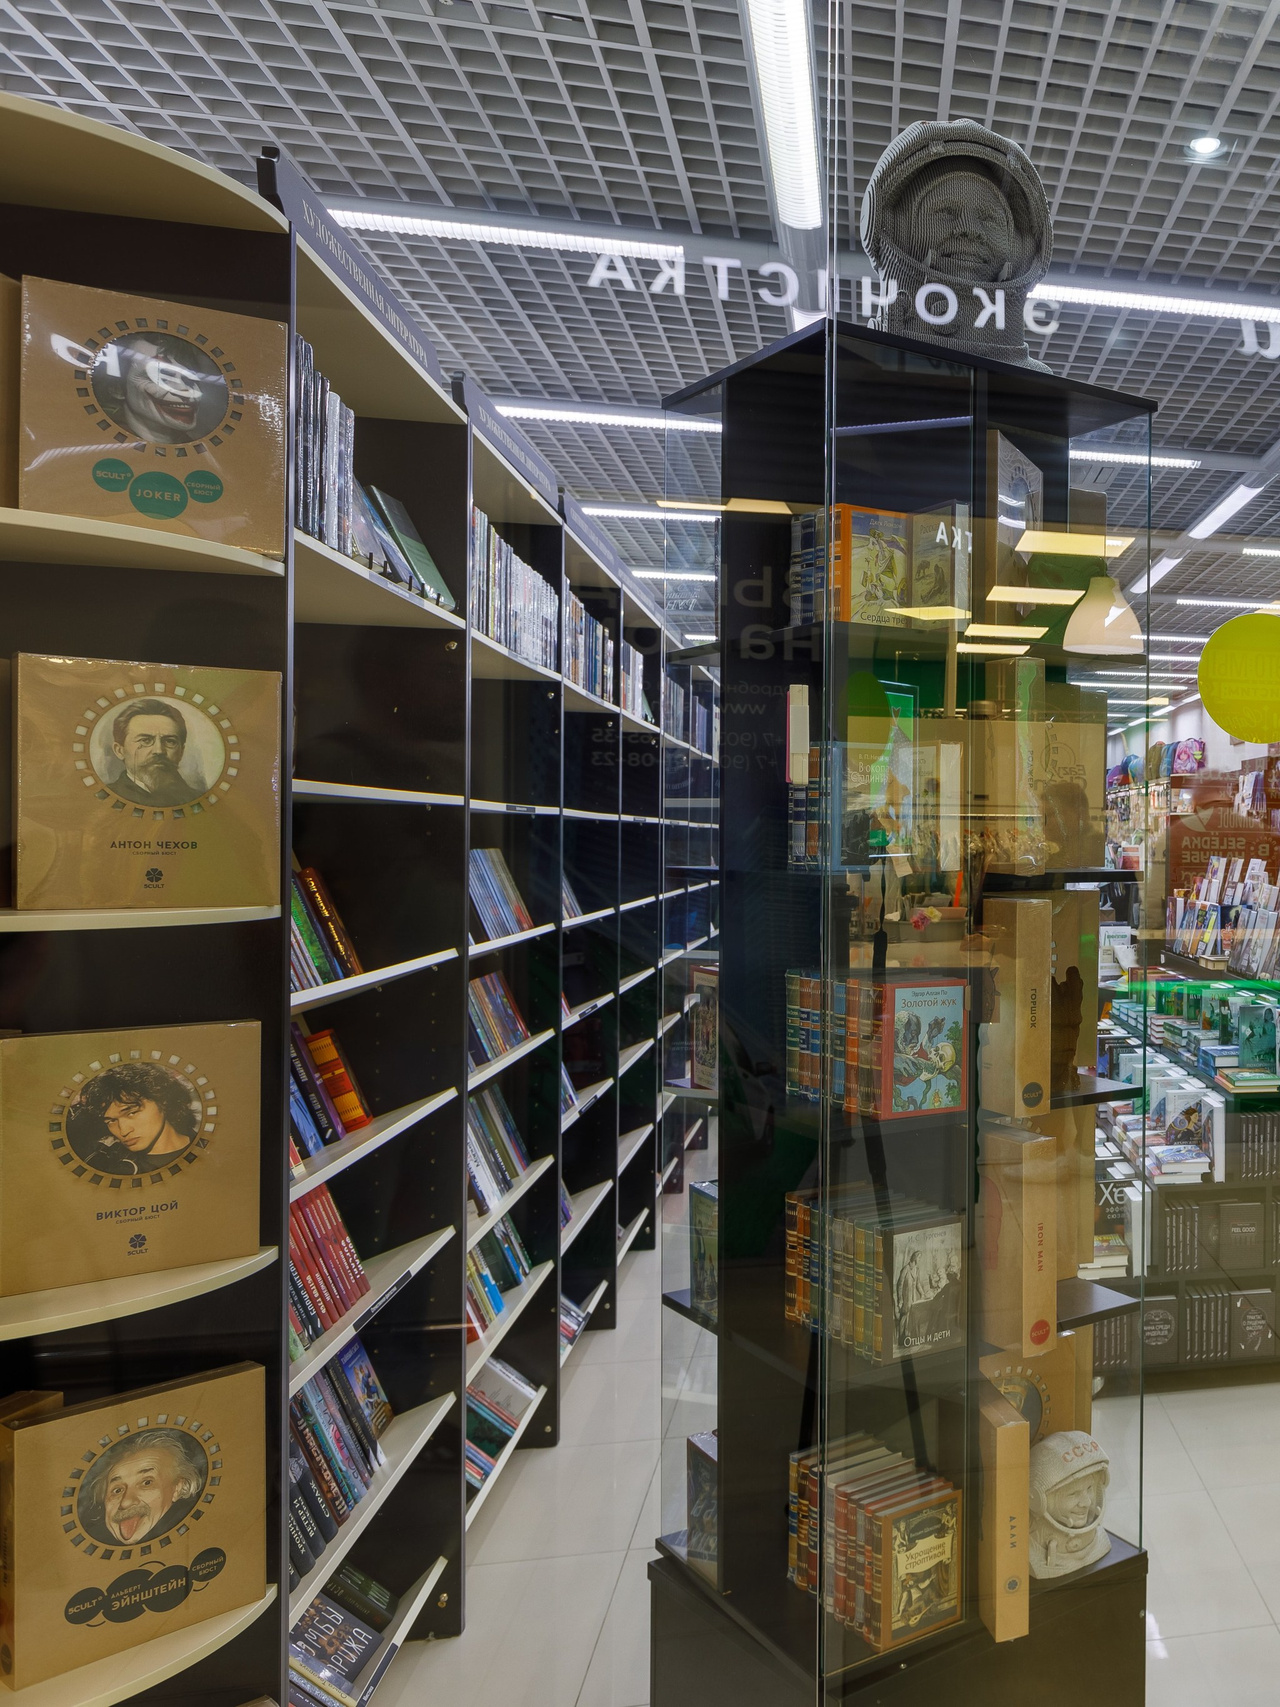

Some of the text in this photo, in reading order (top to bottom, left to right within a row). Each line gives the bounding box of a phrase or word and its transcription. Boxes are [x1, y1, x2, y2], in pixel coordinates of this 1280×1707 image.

[302, 199, 429, 368] ХУДОЖЕСТВЕННАЯ ЛИТЕРАТУРА
[136, 488, 181, 501] JOKER
[860, 611, 890, 623] Сердца
[110, 840, 198, 849] АНТОН ЧЕХОВ
[901, 997, 957, 1009] Золотой жук
[96, 1200, 179, 1221] ВИКТОР ЦОЙ
[116, 1216, 143, 1224] СБОРНЫЙ
[904, 1334, 925, 1347] Отцы
[933, 1329, 951, 1342] дети
[1061, 1441, 1099, 1463] СССР
[308, 1482, 330, 1518] СТРАЖ
[298, 1509, 314, 1538] ВЕТЕР
[904, 1550, 946, 1571] строптивой
[905, 1541, 946, 1562] Укрощение
[192, 1556, 224, 1572] СБОРНЫЙ
[198, 1566, 218, 1576] БЮСТ
[111, 1584, 142, 1599] АЛЬБЕРТ
[111, 1577, 187, 1611] ЭЙНШТЕЙН
